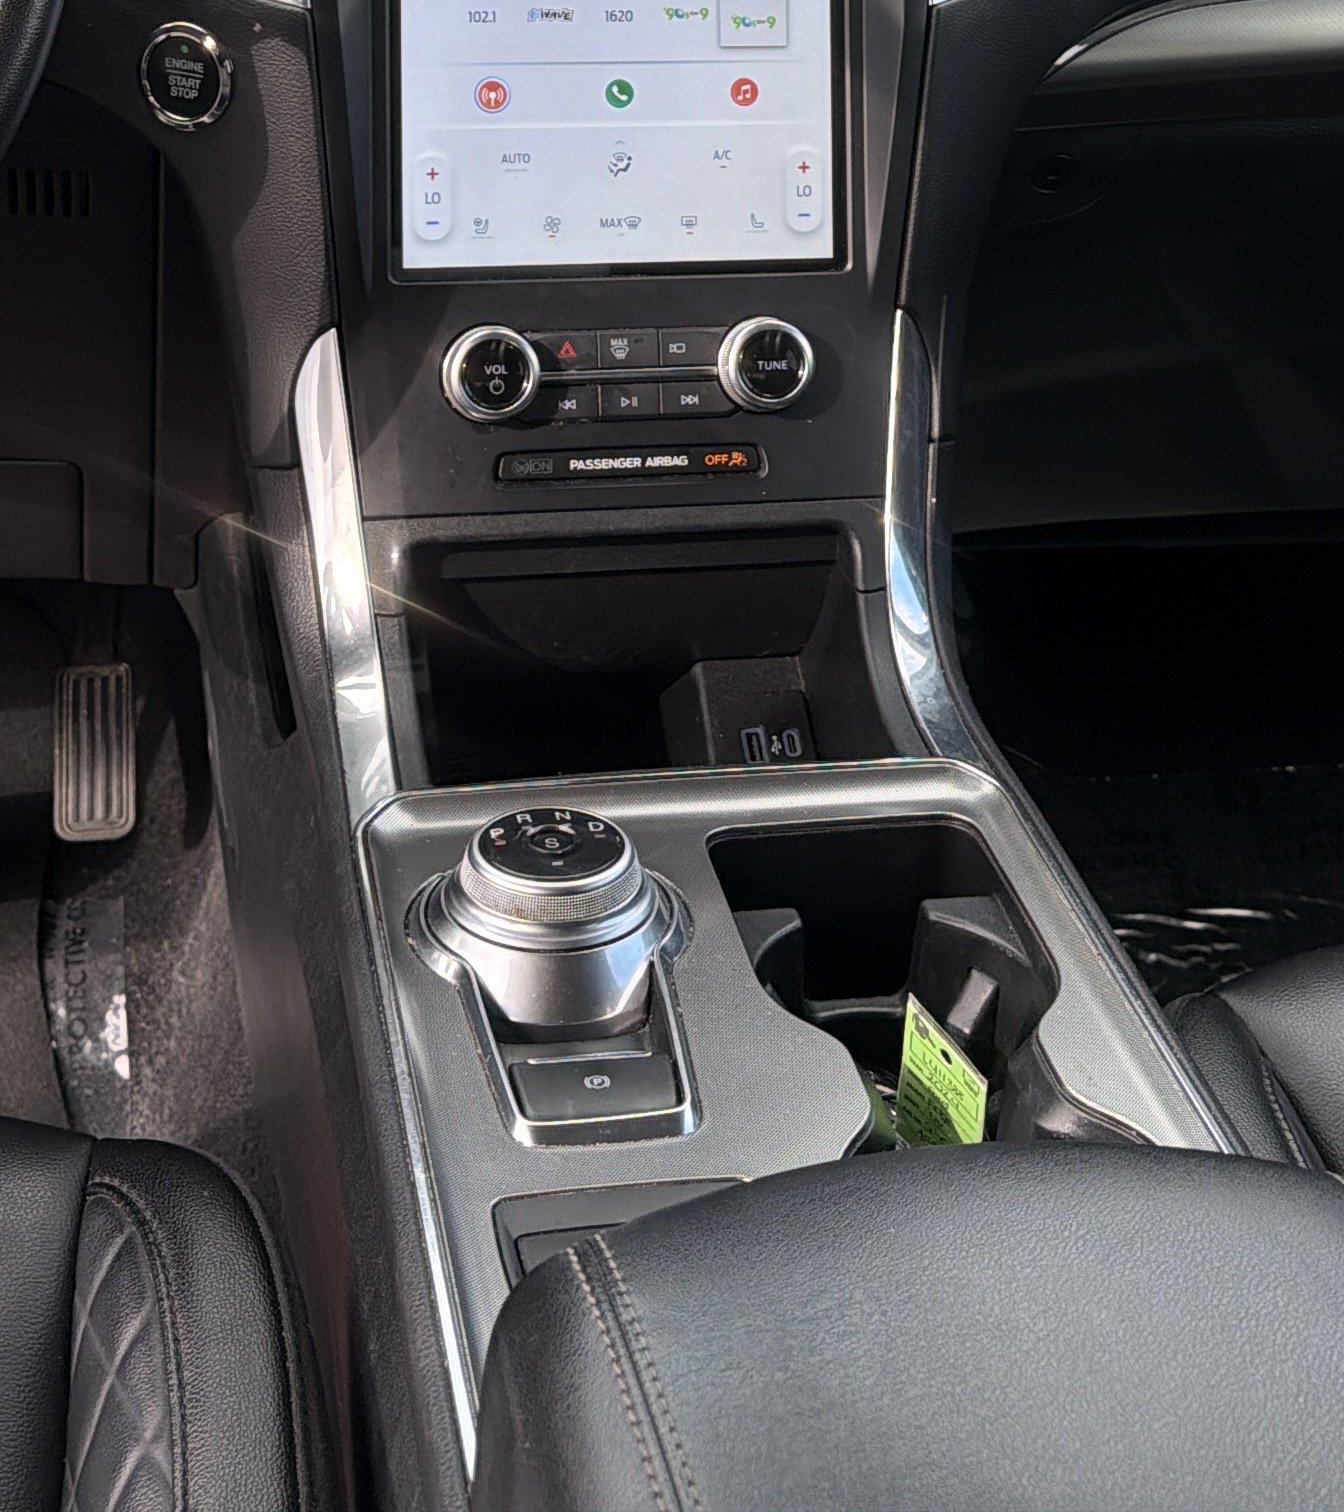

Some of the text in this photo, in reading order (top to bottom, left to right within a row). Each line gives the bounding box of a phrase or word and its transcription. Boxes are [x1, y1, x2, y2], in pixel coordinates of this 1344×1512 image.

[467, 10, 497, 24] 102.1
[604, 9, 634, 23] 1620
[164, 57, 205, 74] ENGINE
[168, 75, 202, 90] START
[169, 86, 199, 100] STOP
[500, 152, 532, 165] AUTO
[712, 149, 733, 162] A/C
[796, 185, 812, 198] LO
[424, 192, 442, 205] LO
[599, 217, 624, 229] MAX
[610, 337, 629, 347] MAX
[483, 363, 509, 375] VOL
[756, 359, 789, 371] TUNE
[569, 455, 689, 471] PASSENGER AIRBAG
[704, 454, 729, 467] OFF
[516, 813, 533, 824] R
[554, 811, 572, 821] N
[587, 821, 605, 832] D
[544, 837, 560, 849] S
